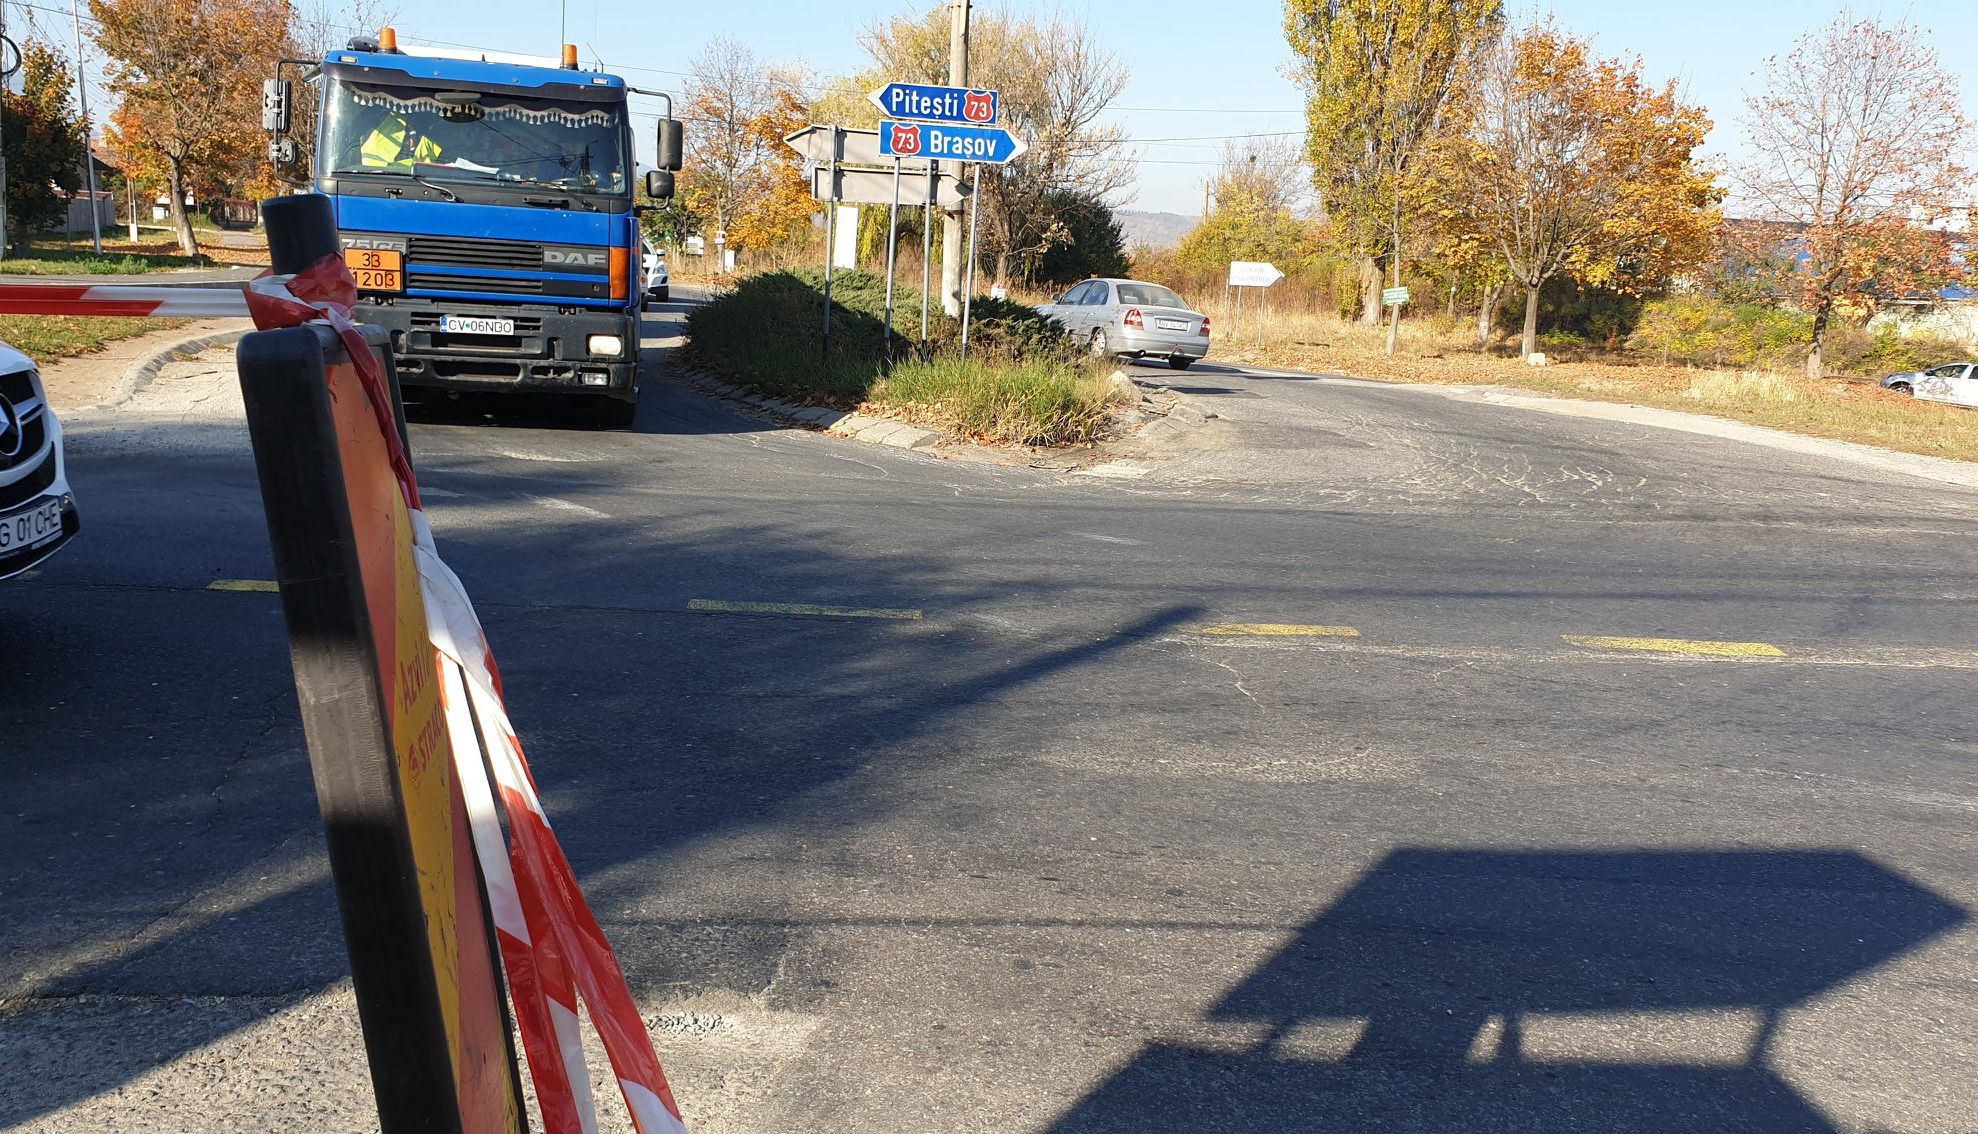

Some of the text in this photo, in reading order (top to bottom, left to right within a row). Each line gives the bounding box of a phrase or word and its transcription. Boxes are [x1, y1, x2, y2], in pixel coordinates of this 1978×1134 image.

[970, 101, 987, 118] 73
[896, 130, 997, 159] 73 Brașov
[362, 252, 381, 268] 33
[544, 251, 606, 265] DAF
[352, 270, 395, 287] 1203
